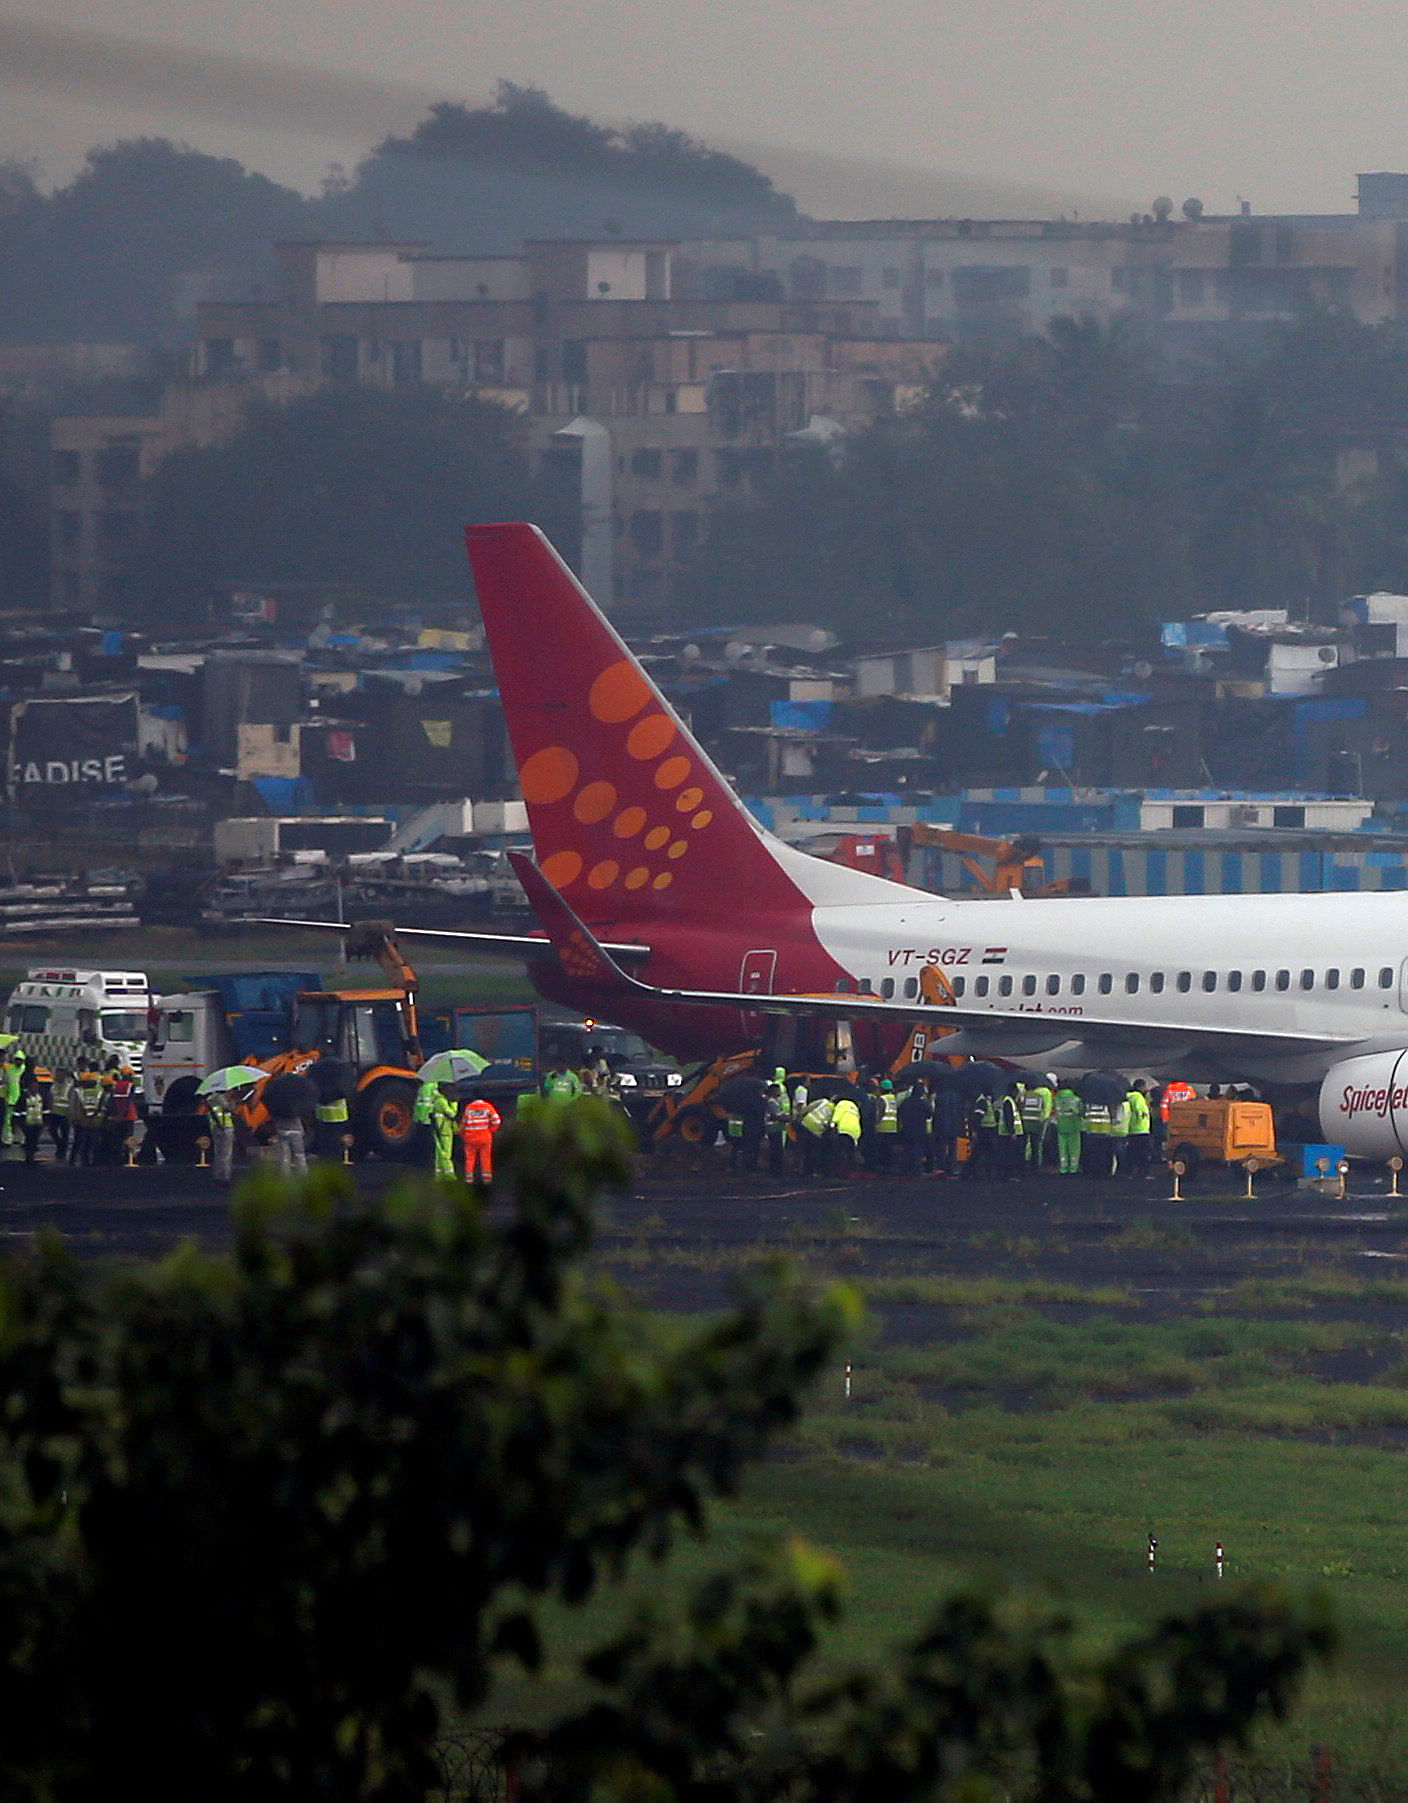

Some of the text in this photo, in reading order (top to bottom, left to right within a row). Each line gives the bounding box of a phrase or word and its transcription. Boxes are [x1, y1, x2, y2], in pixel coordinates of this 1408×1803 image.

[13, 755, 126, 783] ADISE
[888, 948, 971, 965] VT-SGZ
[912, 1033, 925, 1063] CB
